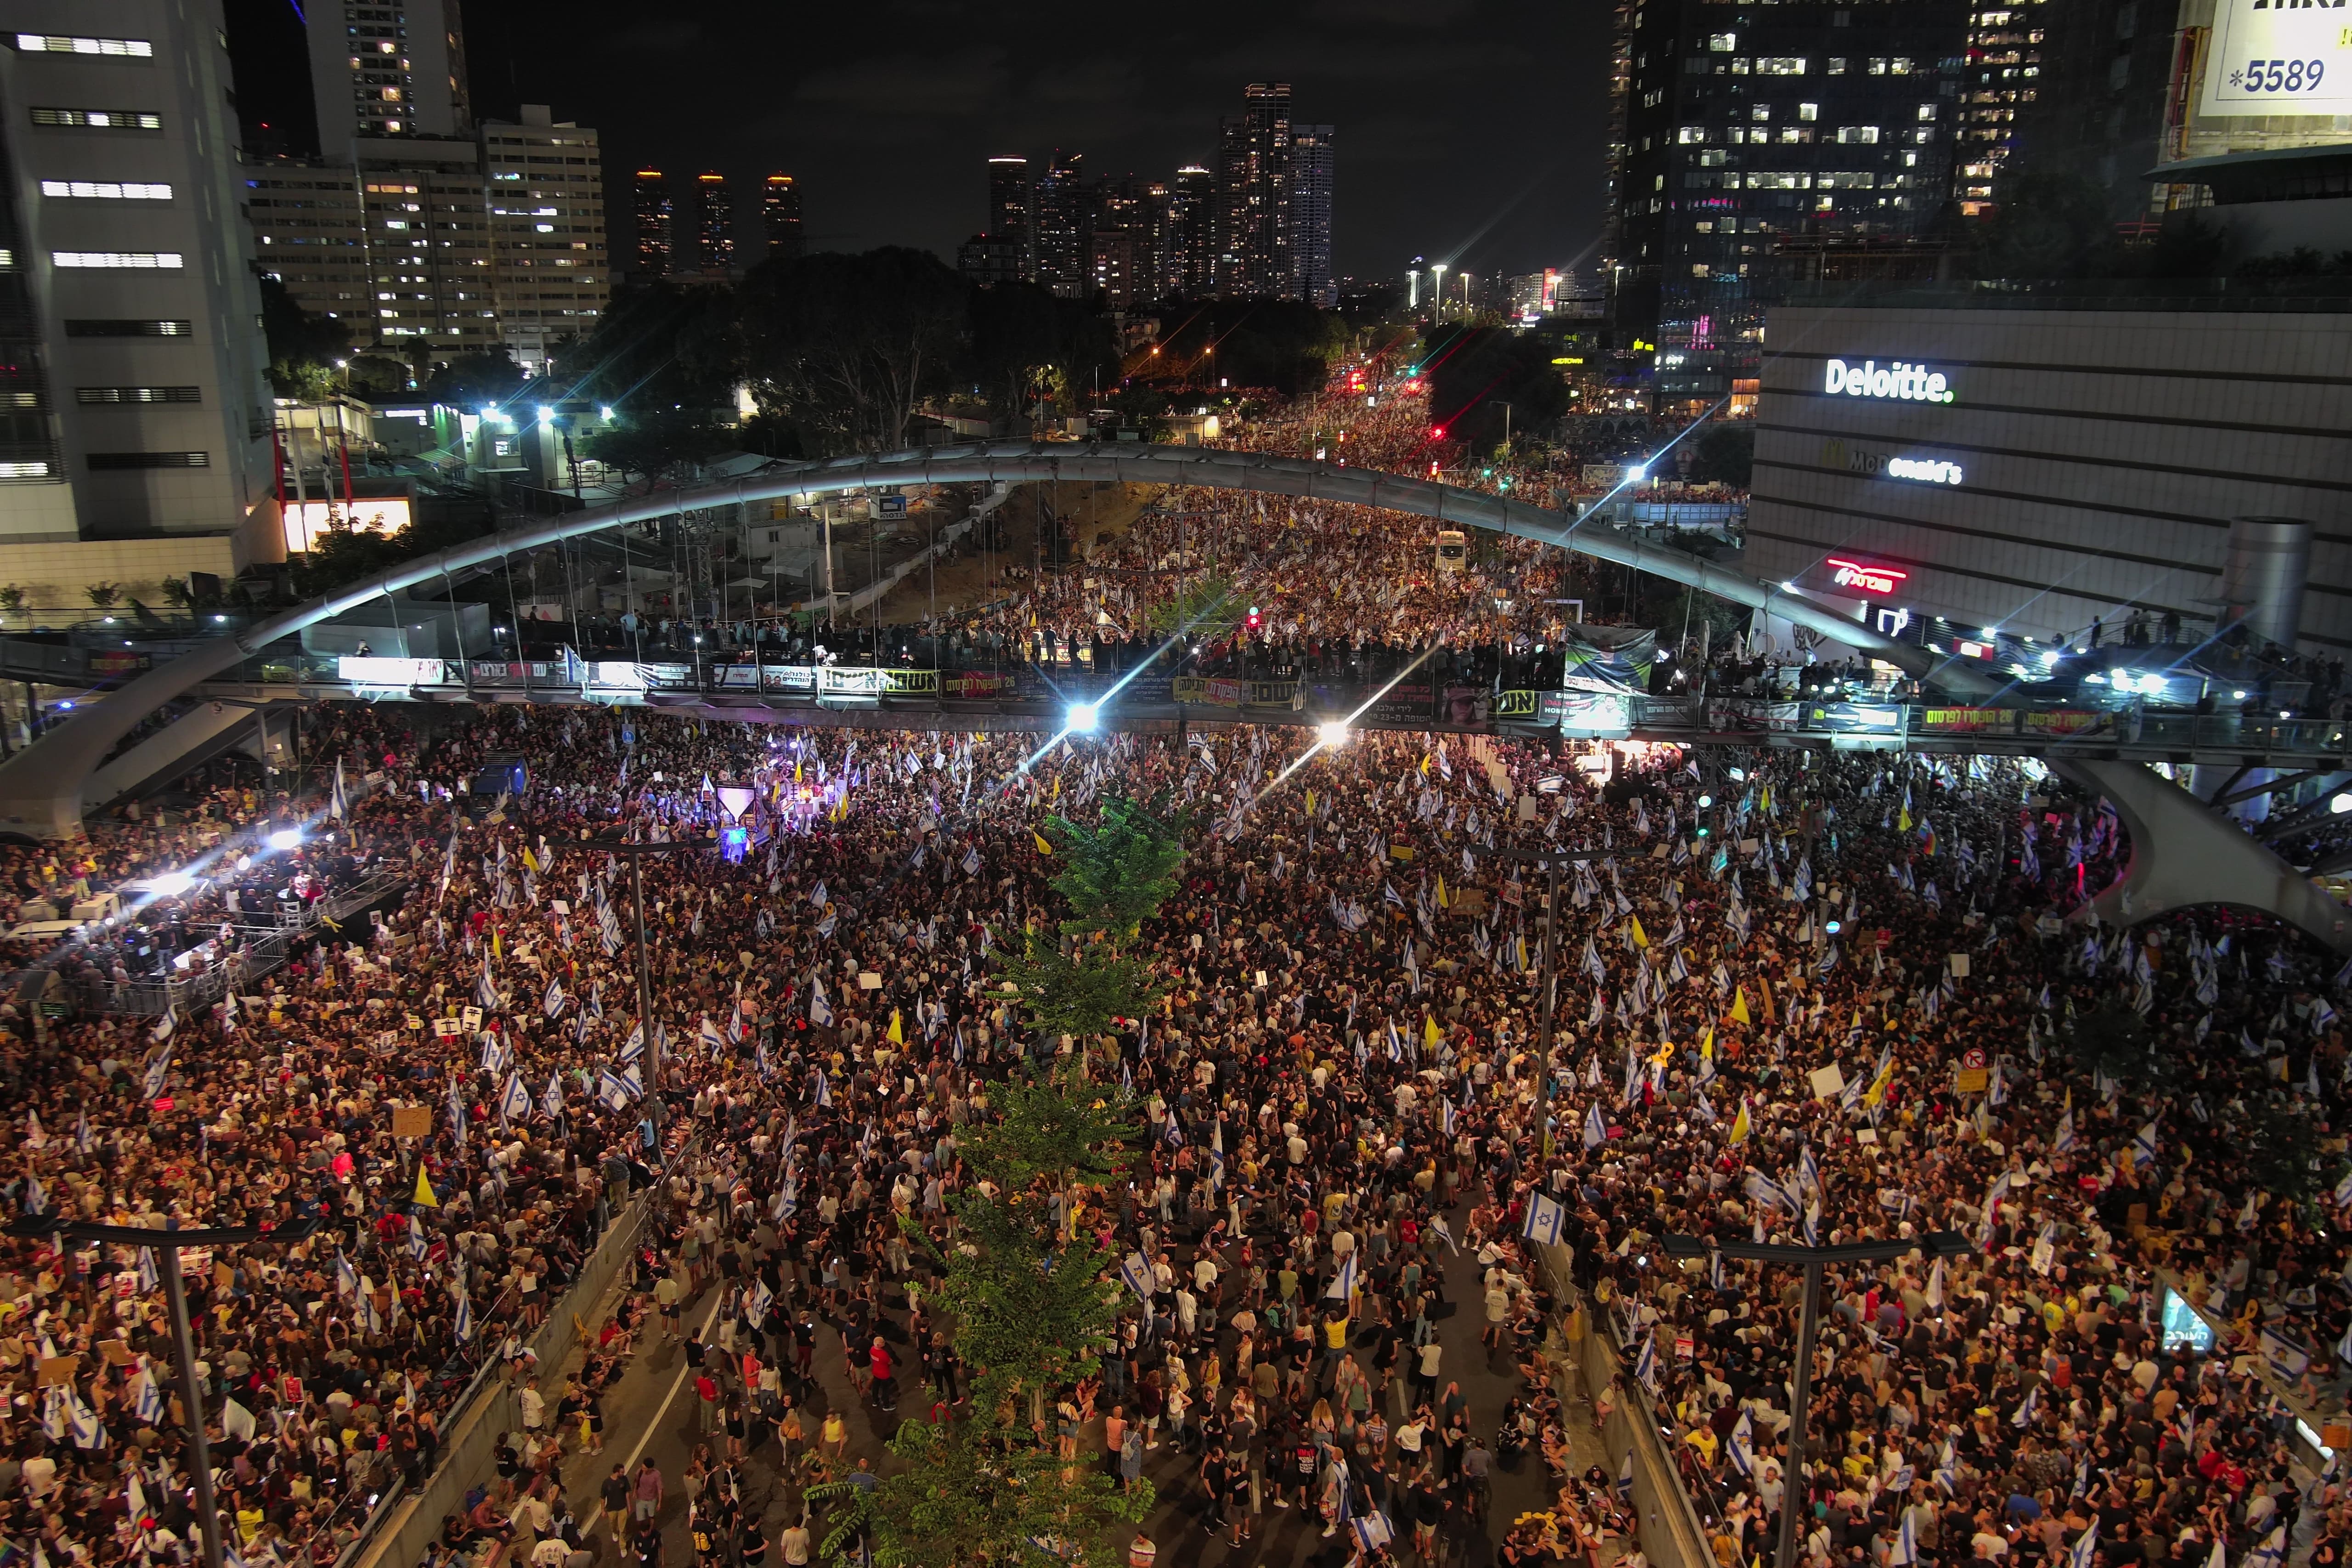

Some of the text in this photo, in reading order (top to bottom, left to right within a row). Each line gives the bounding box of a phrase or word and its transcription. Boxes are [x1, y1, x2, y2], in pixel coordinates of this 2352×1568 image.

[1826, 359, 1954, 402] Deloitte.
[1004, 676, 1016, 688] 26
[1376, 703, 1412, 712] לירי אלבג
[1404, 714, 1431, 723] חטופה
[1999, 709, 2012, 723] 26
[2165, 1330, 2208, 1341] העורב
